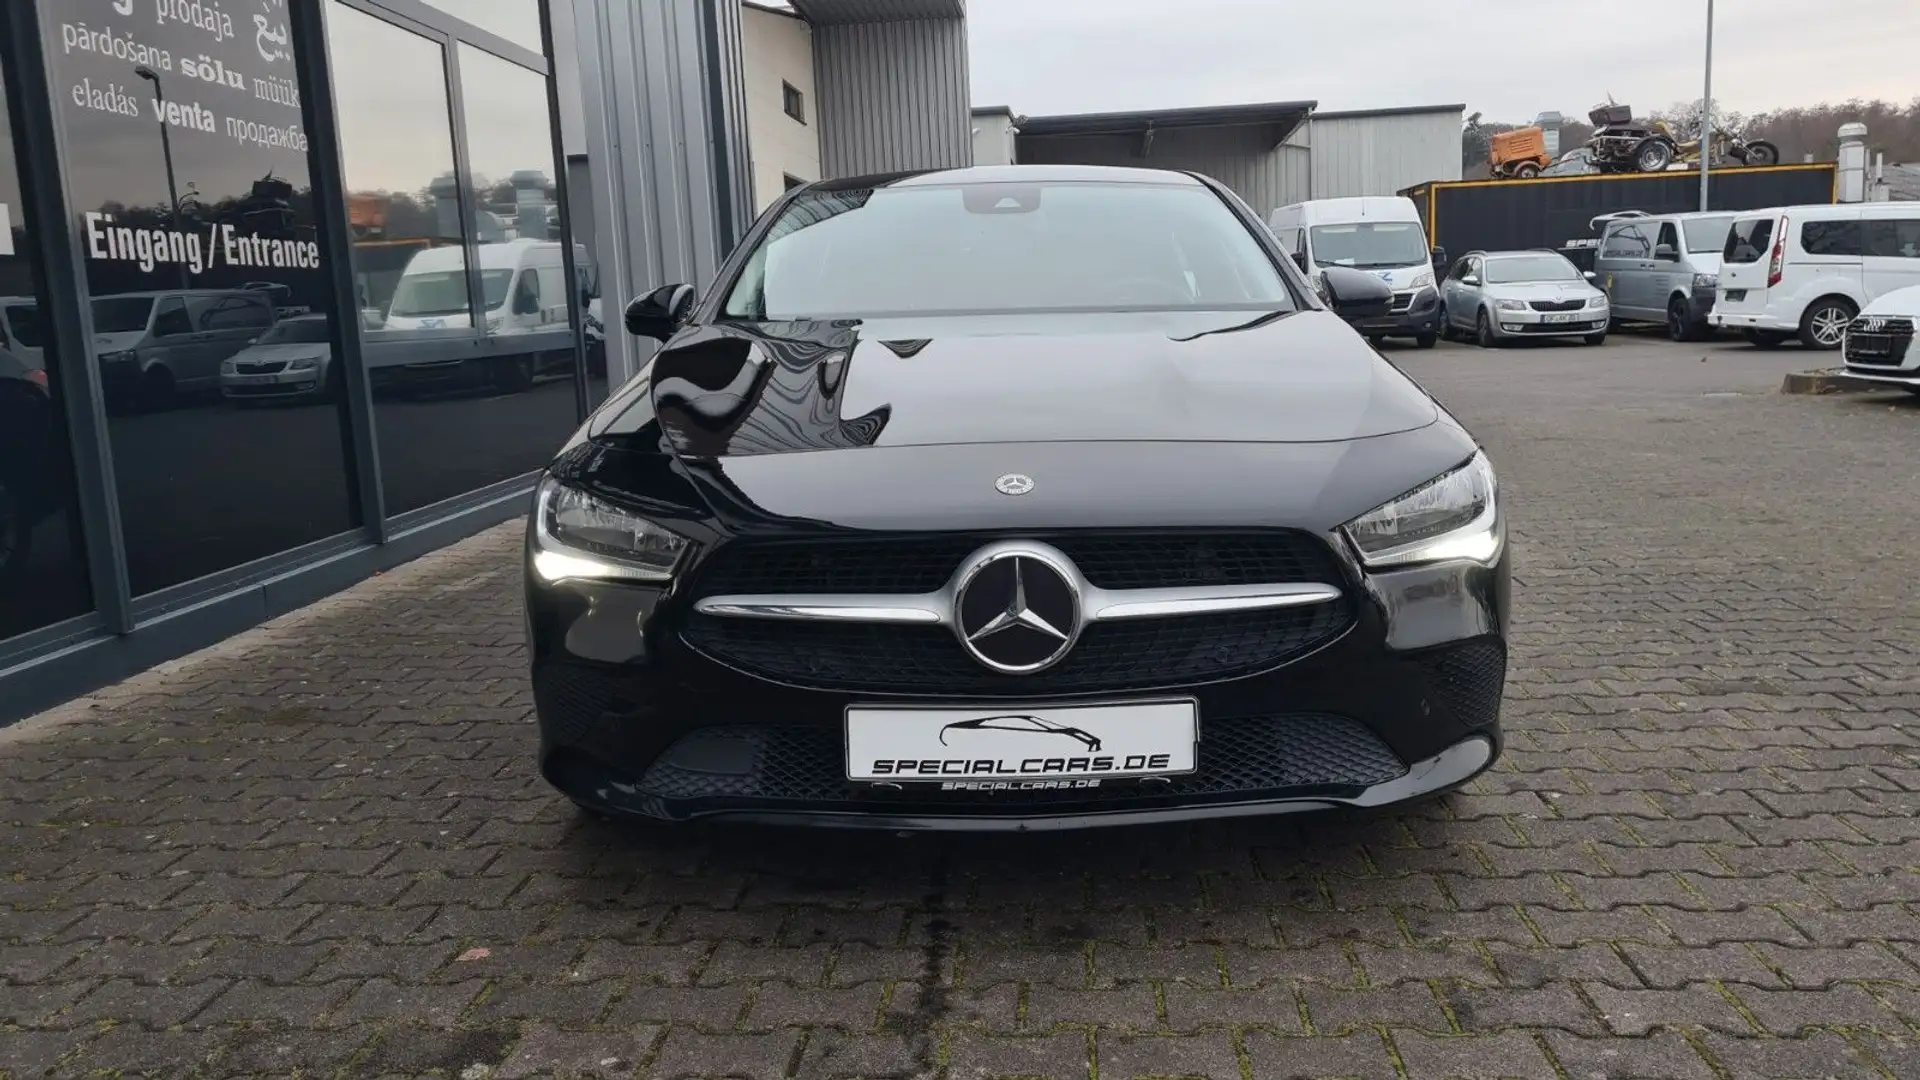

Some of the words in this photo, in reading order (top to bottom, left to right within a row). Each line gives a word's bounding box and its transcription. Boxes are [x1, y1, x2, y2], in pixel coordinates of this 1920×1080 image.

[156, 0, 235, 41] prodaja
[62, 21, 172, 71] pārdošana
[180, 54, 247, 91] sölu
[253, 76, 301, 109] müük
[72, 78, 139, 117] eladás
[152, 98, 217, 133] venta
[226, 116, 309, 152] продажба
[872, 753, 1171, 775] SPECIALCARS.DE
[941, 779, 1102, 792] SPECIALCARS.DE
